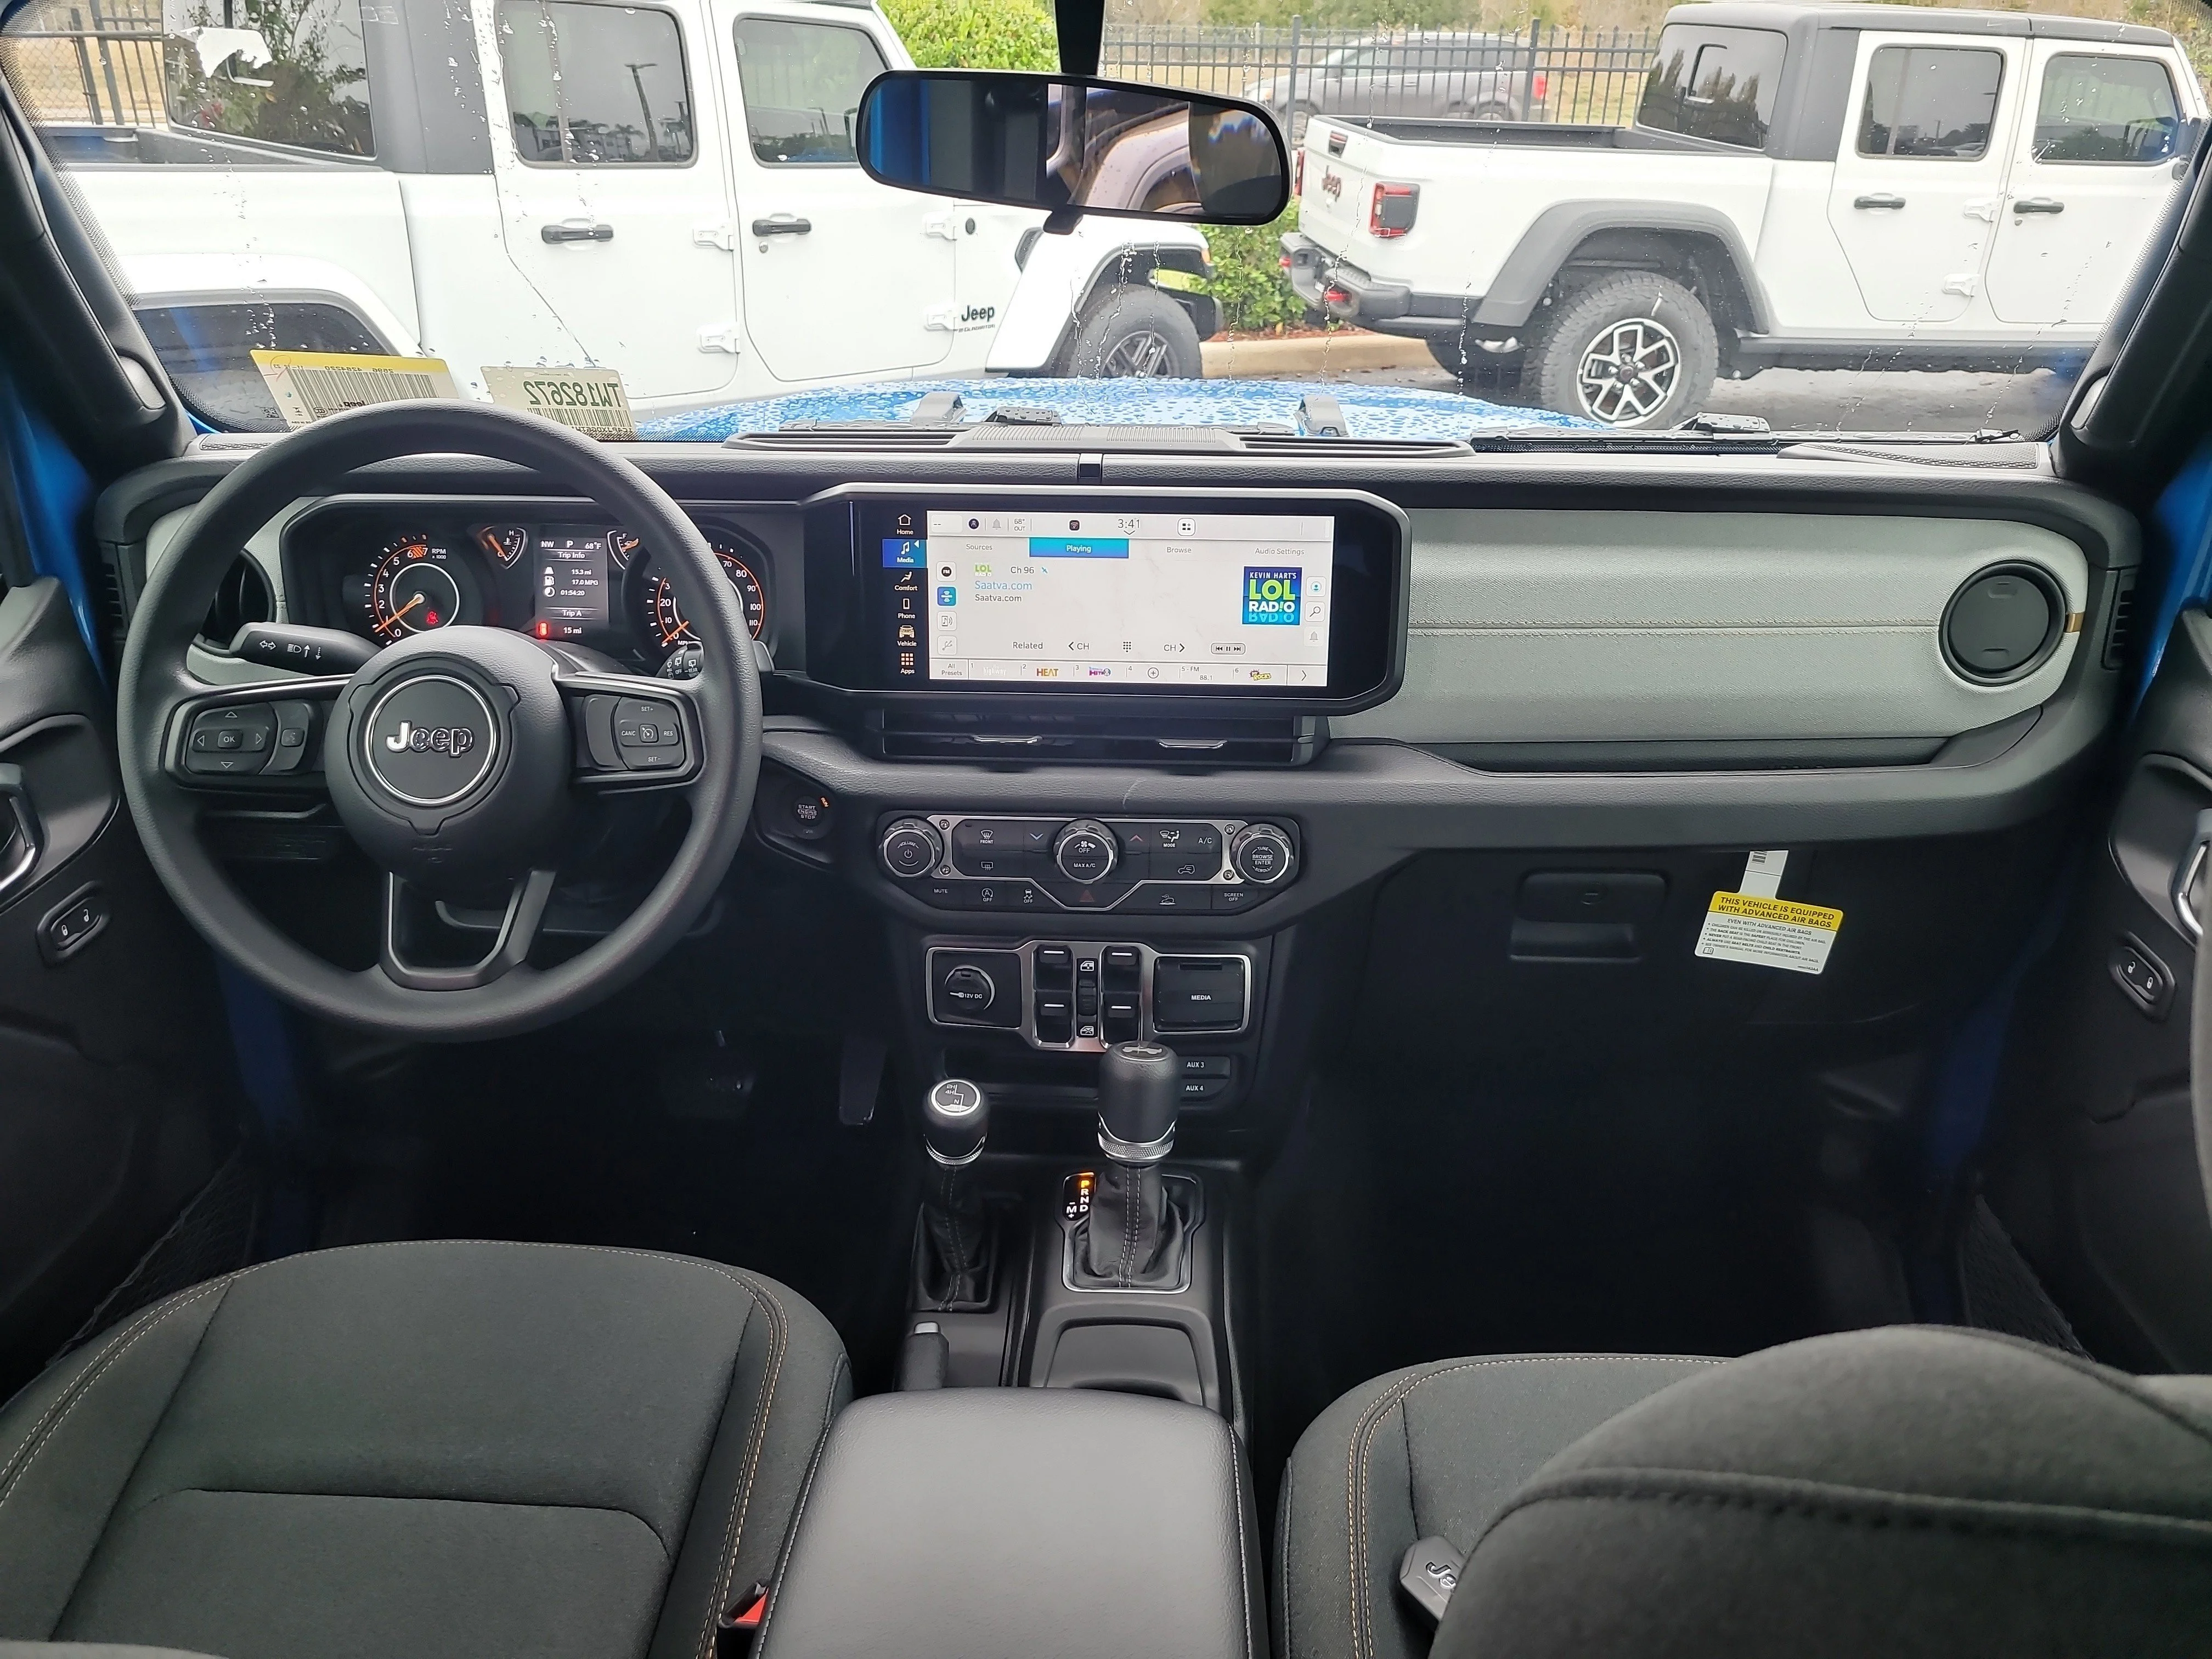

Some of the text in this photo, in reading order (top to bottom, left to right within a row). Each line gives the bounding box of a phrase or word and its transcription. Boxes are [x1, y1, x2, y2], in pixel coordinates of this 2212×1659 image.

[962, 305, 995, 322] Jeep
[1118, 519, 1141, 528] 3:41
[407, 550, 413, 558] 6
[422, 548, 428, 556] 7
[1066, 545, 1091, 554] Playing
[393, 557, 400, 566] 5
[383, 569, 389, 578] 4
[736, 569, 747, 578] 80
[378, 584, 385, 593] 3
[975, 581, 1032, 590] Saatva.com
[1249, 579, 1296, 600] LOL
[379, 600, 385, 609] 2
[394, 628, 402, 637] 0
[1036, 668, 1059, 676] HEAT
[223, 736, 235, 744] OK
[385, 720, 473, 757] Jeep
[1742, 900, 1779, 911] VEHICLE
[1790, 907, 1835, 920] EQUIPPED
[1718, 905, 1740, 913] WITH
[1741, 908, 1789, 920] ADVANCED
[1808, 918, 1832, 928] BAGS
[1757, 923, 1786, 931] ADVANCED
